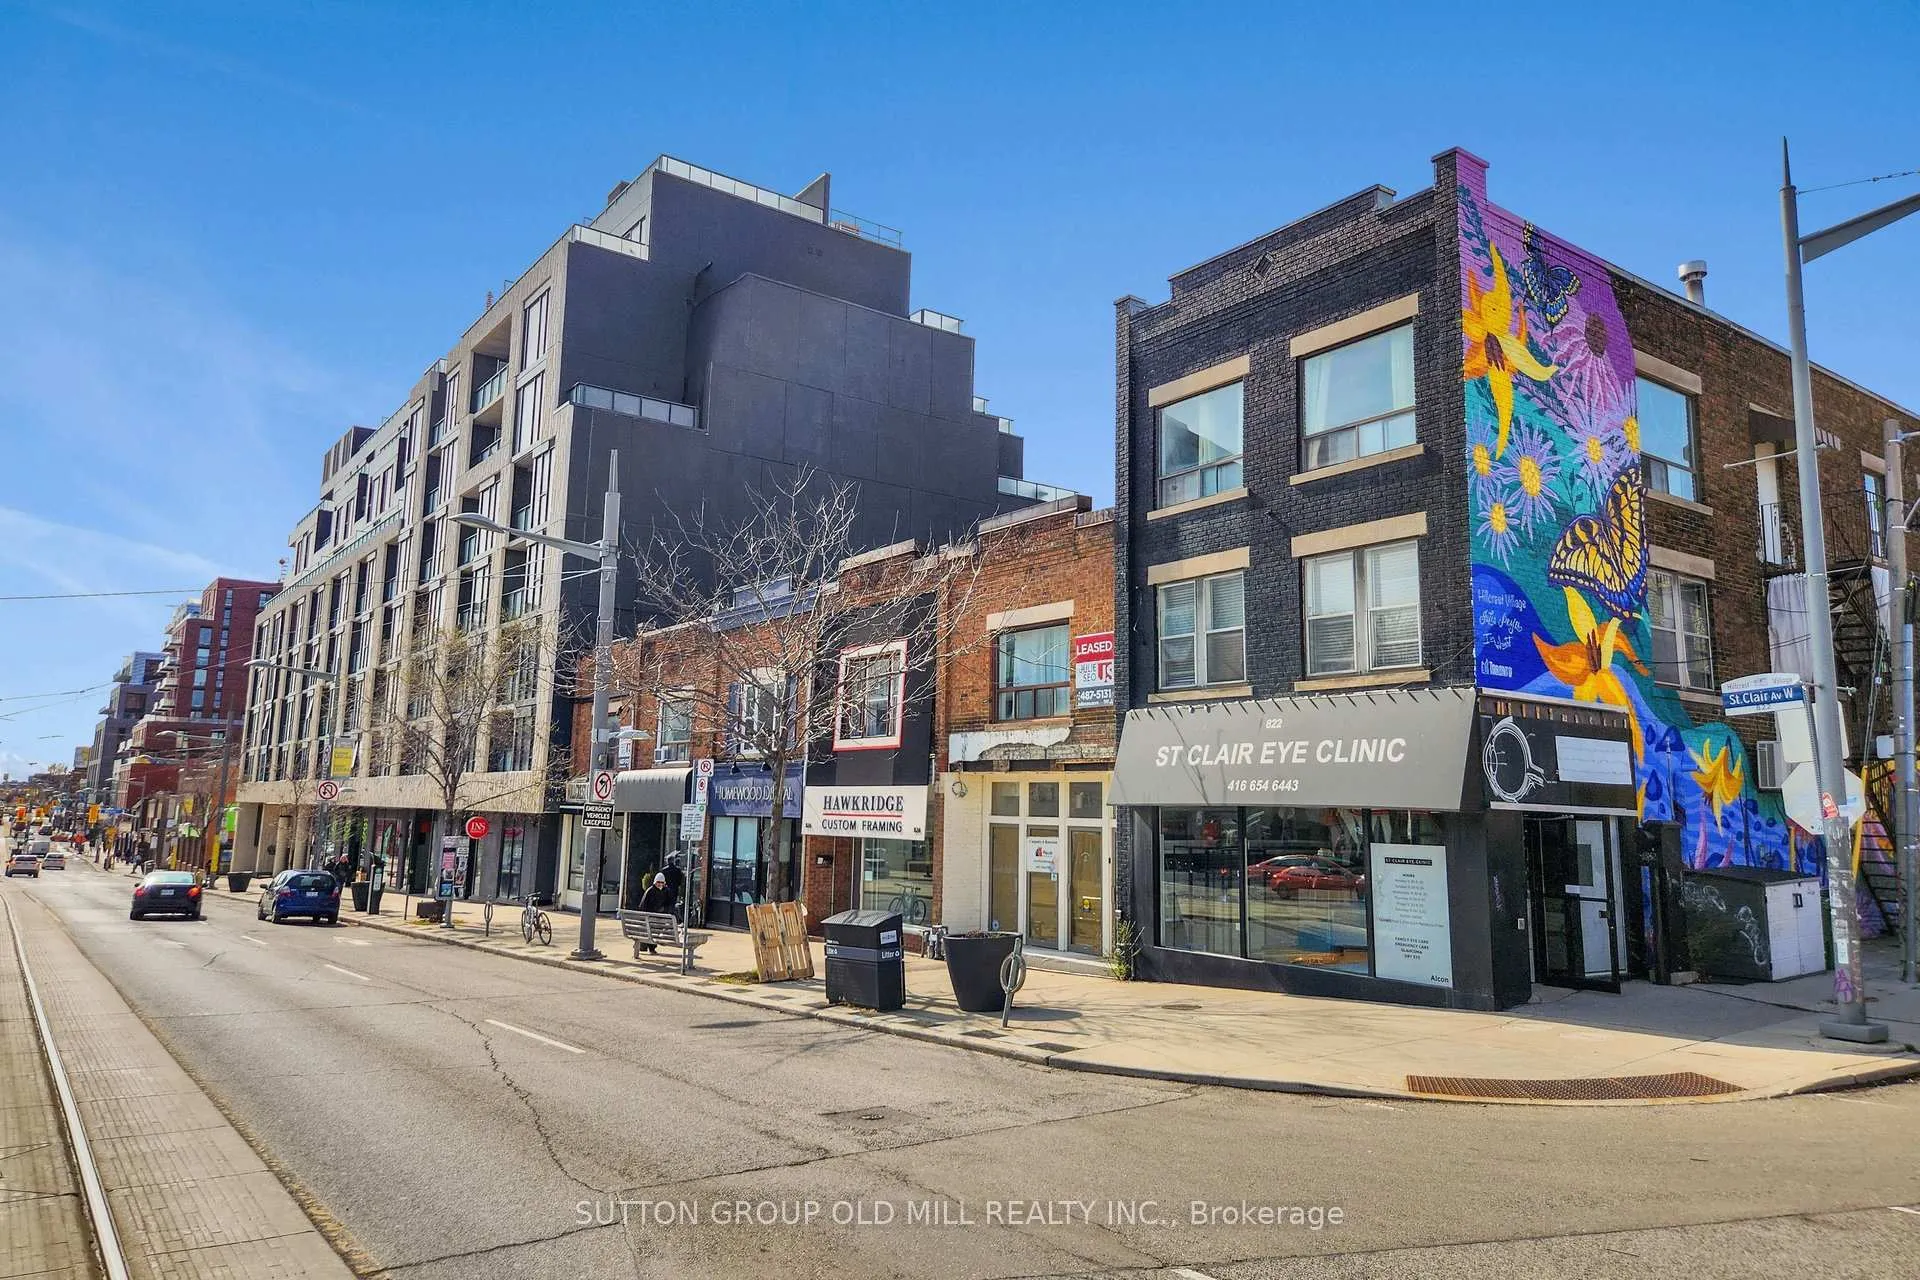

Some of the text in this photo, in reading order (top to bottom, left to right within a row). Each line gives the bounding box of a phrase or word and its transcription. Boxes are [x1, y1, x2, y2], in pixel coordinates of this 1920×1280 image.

[1076, 640, 1113, 656] LEASED
[1488, 660, 1513, 678] Toronto
[1083, 673, 1097, 682] SEO
[1080, 688, 1112, 700] 487-5131
[1770, 692, 1782, 701] Av
[1783, 687, 1793, 699] W
[1265, 718, 1283, 729] 822
[1155, 737, 1407, 767] ST CLAIR EYE CLINIC
[1227, 779, 1299, 792] 416 654 6443
[763, 786, 793, 801] DEAL
[585, 805, 612, 813] EMERGENCY
[823, 795, 904, 812] HAWKRIDGE
[586, 812, 610, 820] VEHICLES
[821, 819, 857, 830] CUSTOM
[861, 820, 903, 833] FRAMING
[1430, 974, 1449, 983] Alcon
